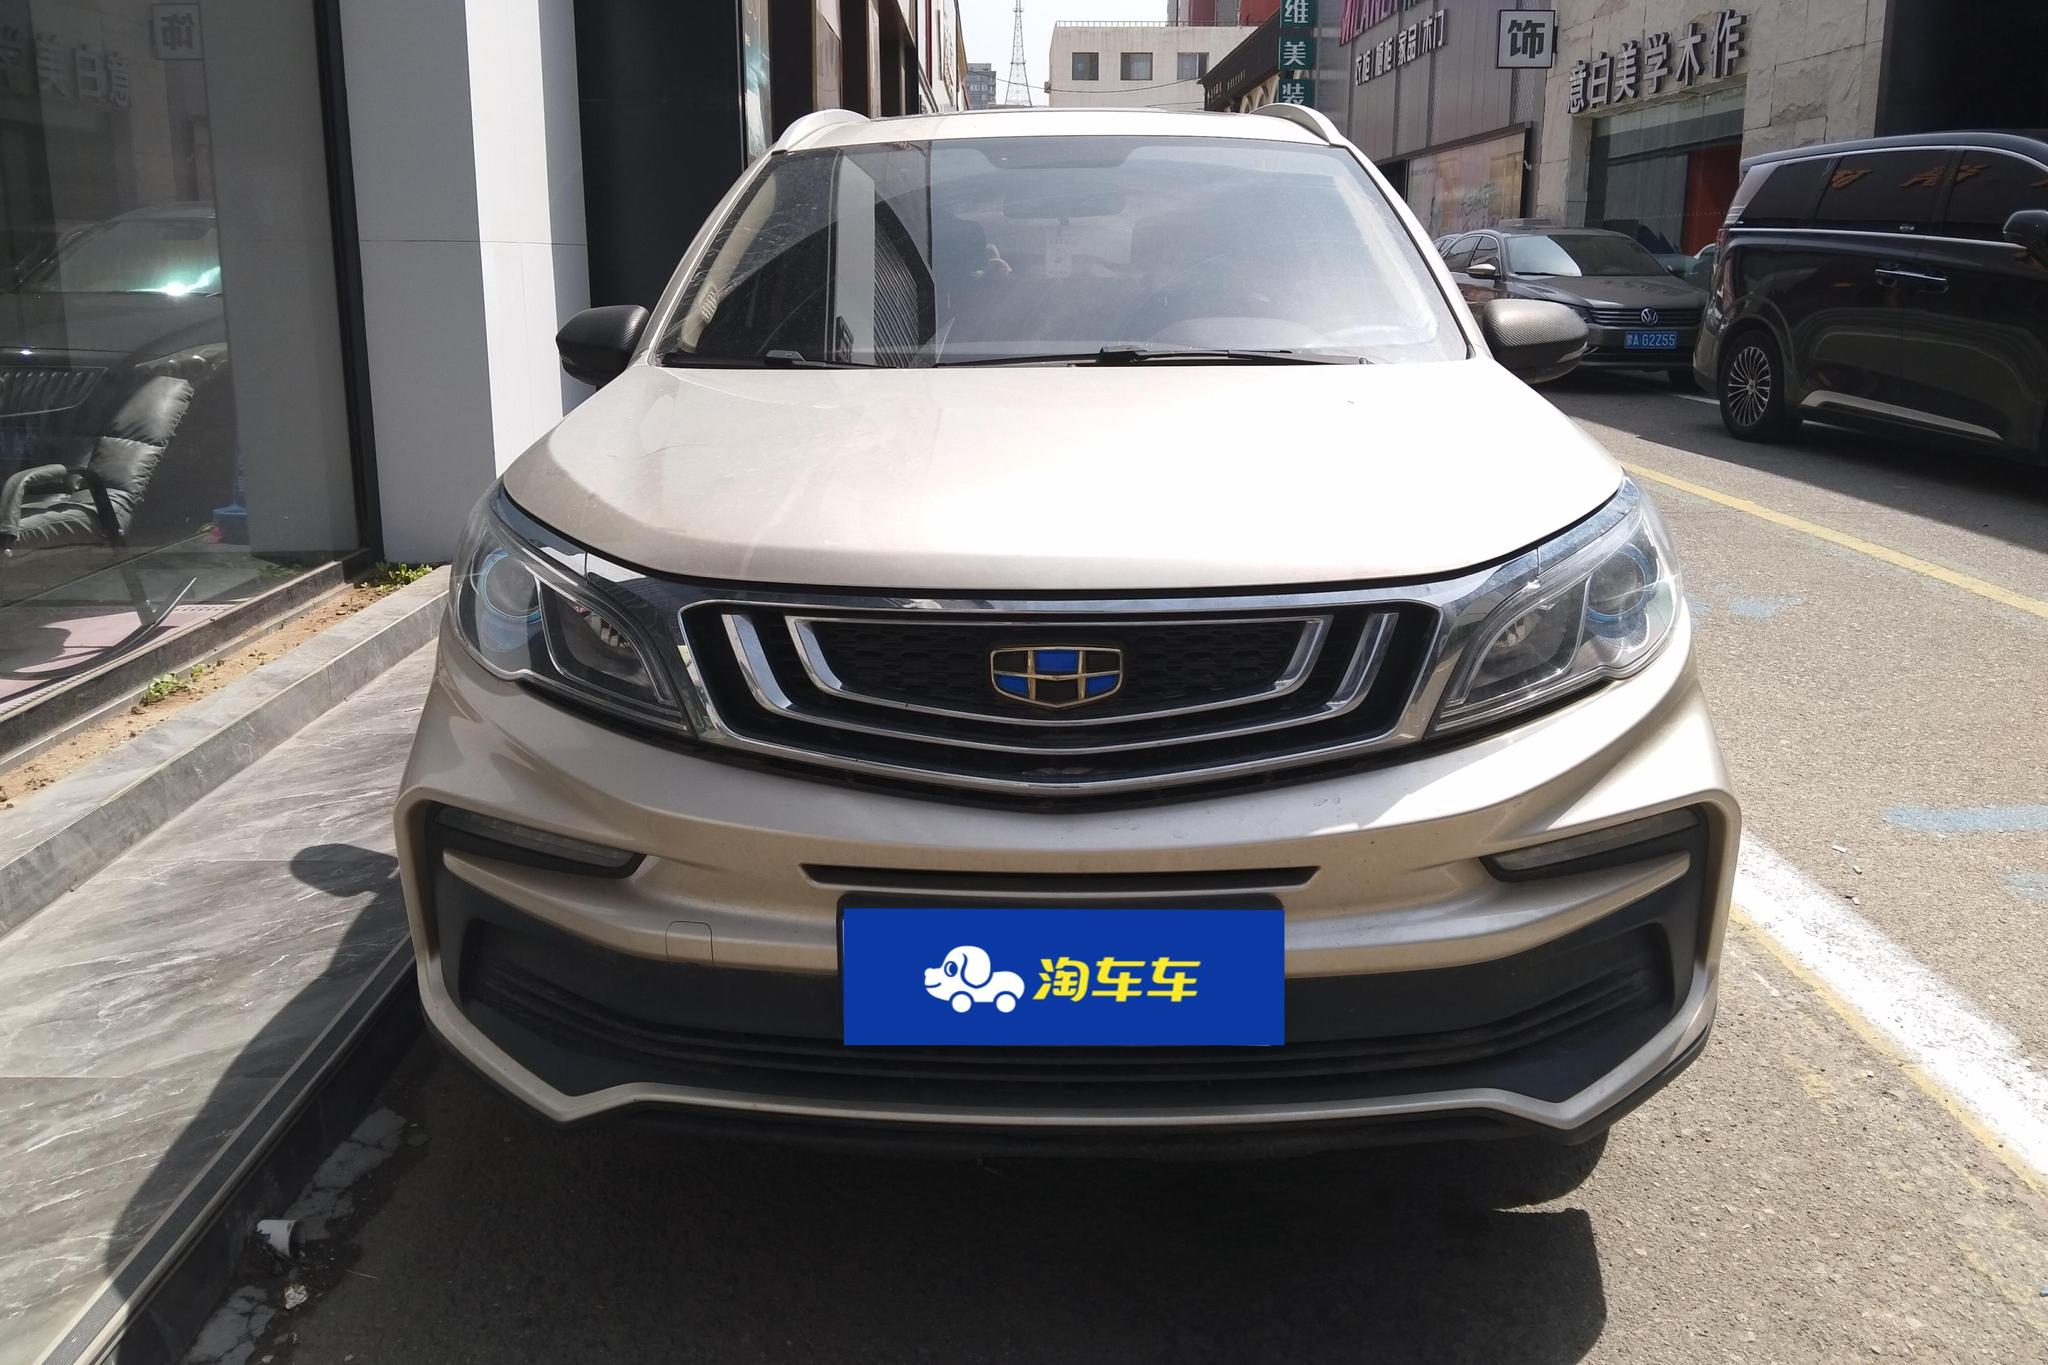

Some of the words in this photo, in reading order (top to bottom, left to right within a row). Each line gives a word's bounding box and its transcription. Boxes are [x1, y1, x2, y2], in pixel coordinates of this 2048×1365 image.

[1507, 19, 1546, 59] 饰
[1566, 9, 1747, 114] 意白美学木作
